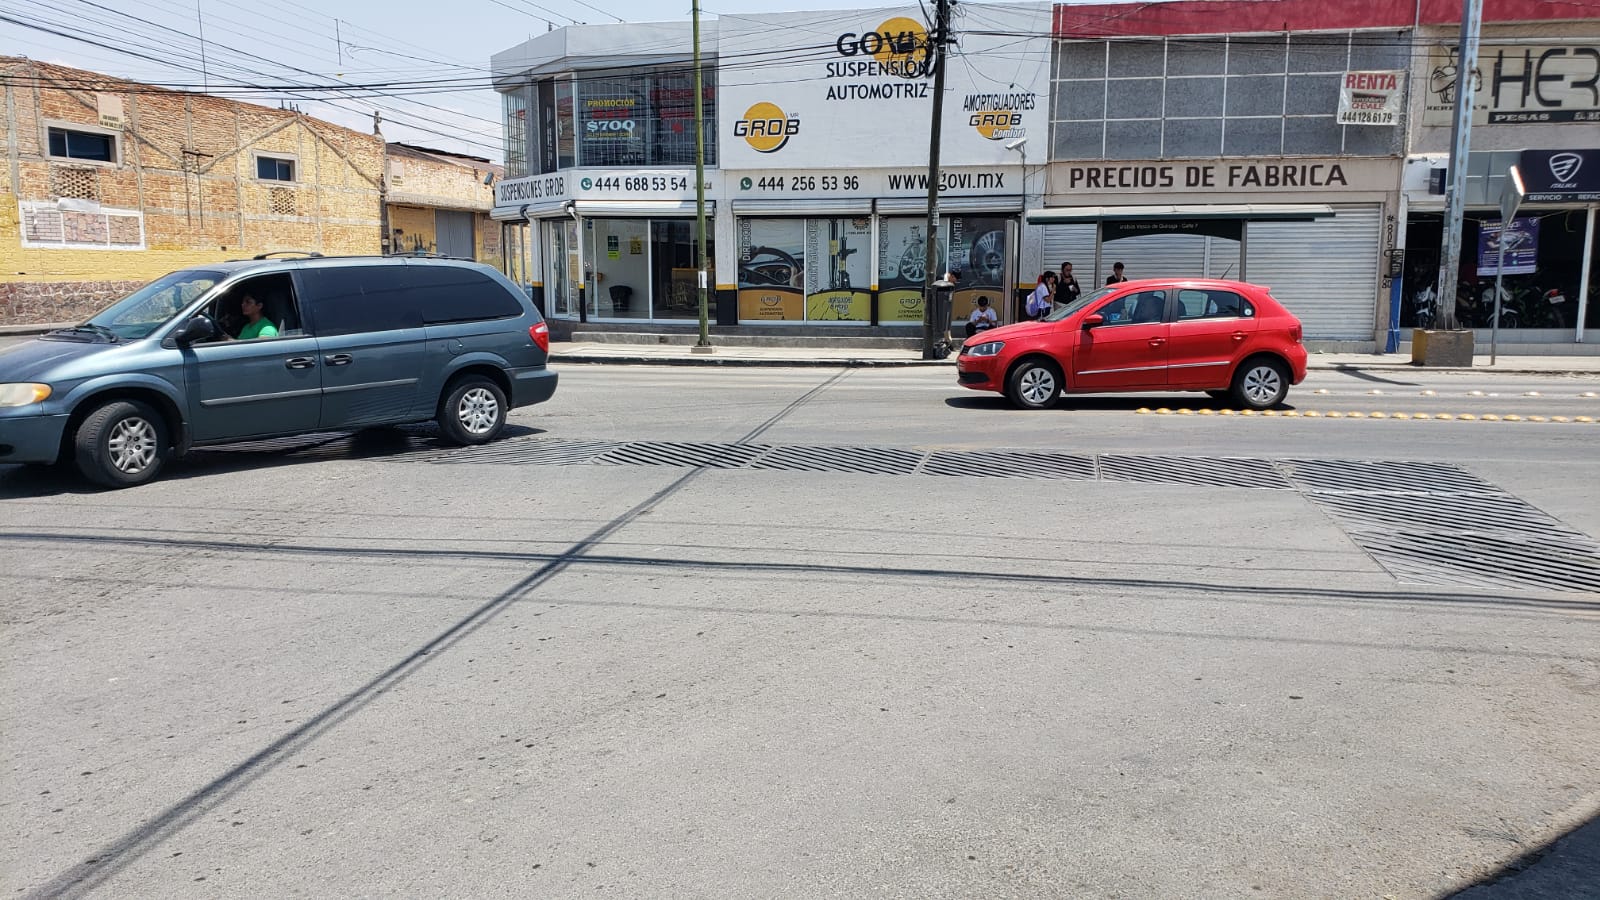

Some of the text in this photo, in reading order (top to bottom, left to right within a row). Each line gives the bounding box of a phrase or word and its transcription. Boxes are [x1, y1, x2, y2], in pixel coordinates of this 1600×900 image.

[1346, 73, 1397, 90] RENTA
[826, 82, 928, 100] AUTOMOTRIZ
[963, 93, 1036, 112] AMORTIGUADORES
[969, 113, 1022, 126] GROB
[1494, 113, 1550, 121] PESAS
[586, 120, 636, 132] $700
[733, 119, 801, 137] GROB
[992, 127, 1026, 138] Comfort
[595, 177, 620, 191] 444
[625, 177, 649, 191] 688
[652, 177, 666, 190] 53
[671, 177, 687, 190] 54
[758, 175, 859, 191] 444 256 53 96
[1070, 164, 1348, 188] PRECIOS DE FABRICA
[501, 176, 565, 201] SUSPENSIONES GROB
